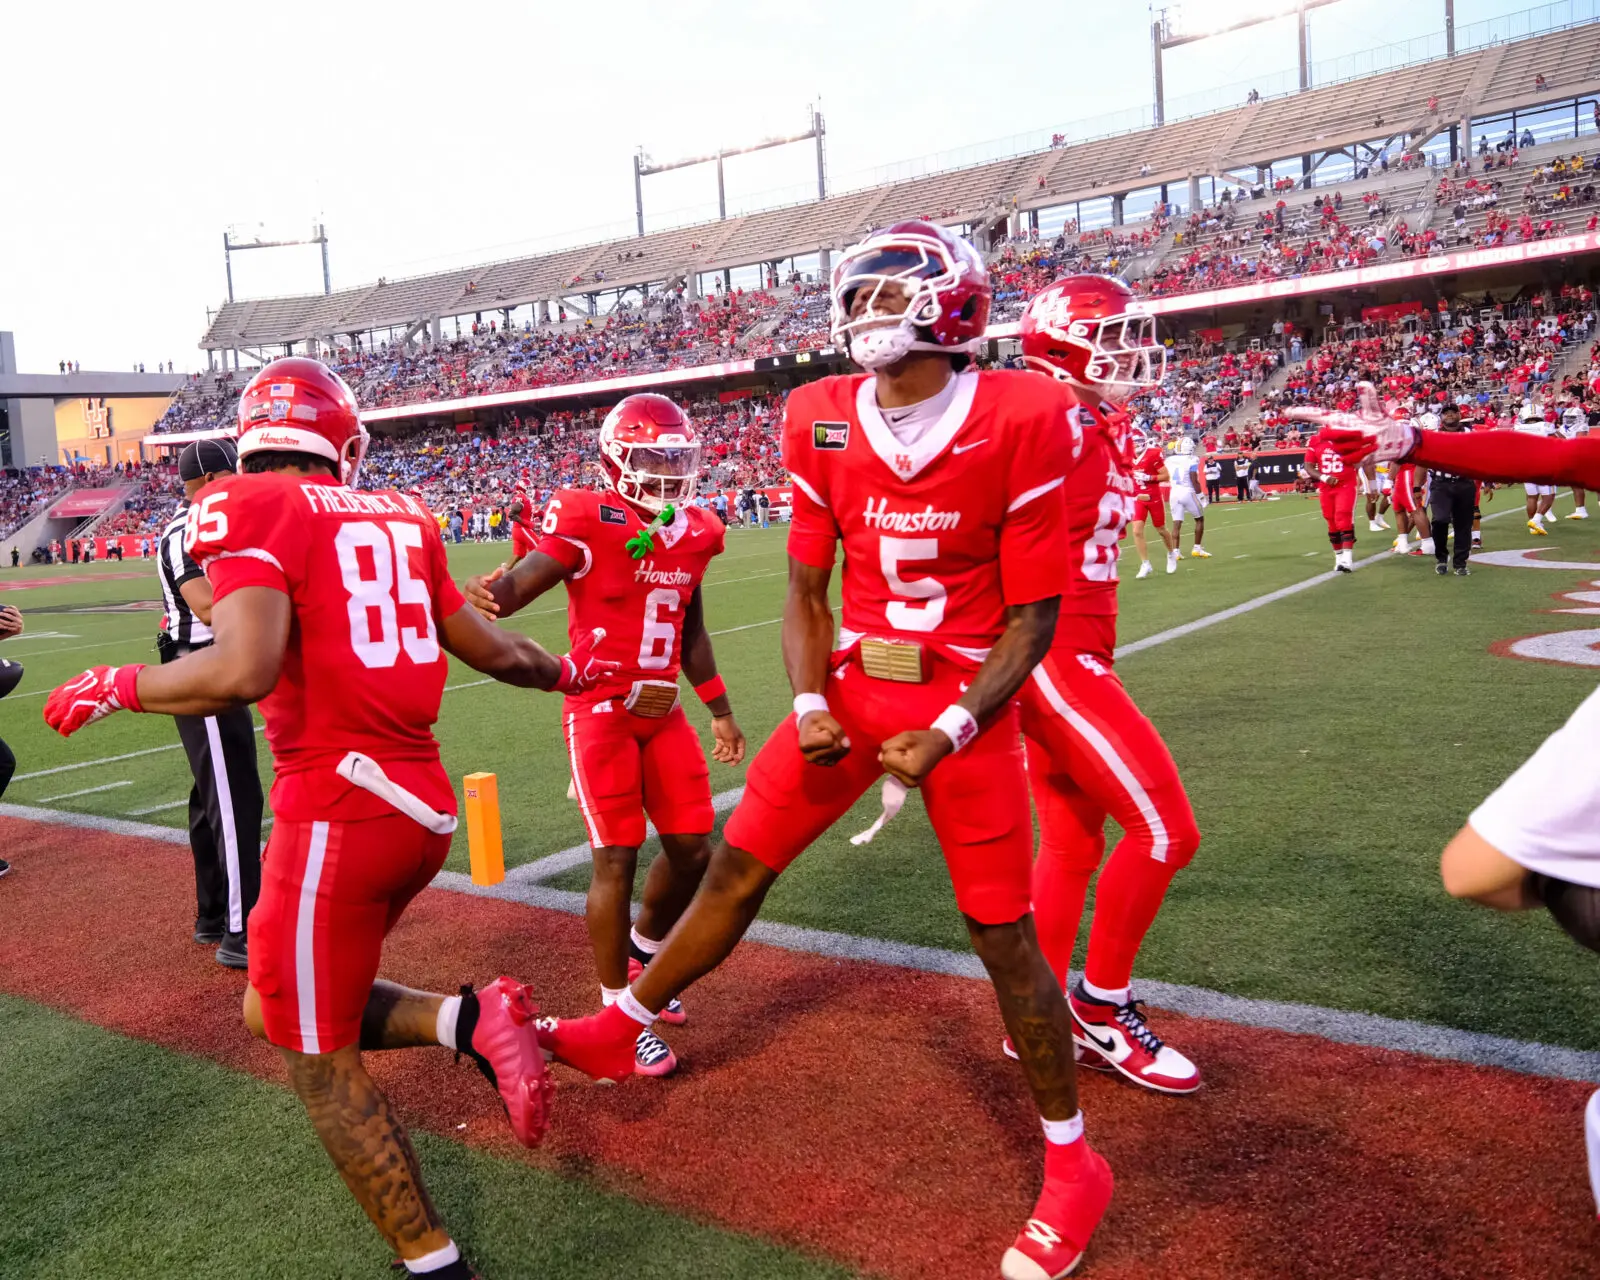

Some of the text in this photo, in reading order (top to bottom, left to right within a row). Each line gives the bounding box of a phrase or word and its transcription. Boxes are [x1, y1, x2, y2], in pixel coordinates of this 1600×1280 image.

[259, 432, 300, 446] Houston
[1257, 464, 1281, 475] IVE
[1321, 453, 1344, 474] 56
[300, 484, 405, 514] FREDERICK
[541, 499, 562, 534] 6
[861, 496, 962, 533] Houston
[182, 491, 230, 554] 85
[1081, 491, 1136, 582] 8
[634, 559, 692, 586] Houston
[879, 535, 948, 632] 5
[334, 521, 441, 669] 85
[637, 587, 681, 670] 6
